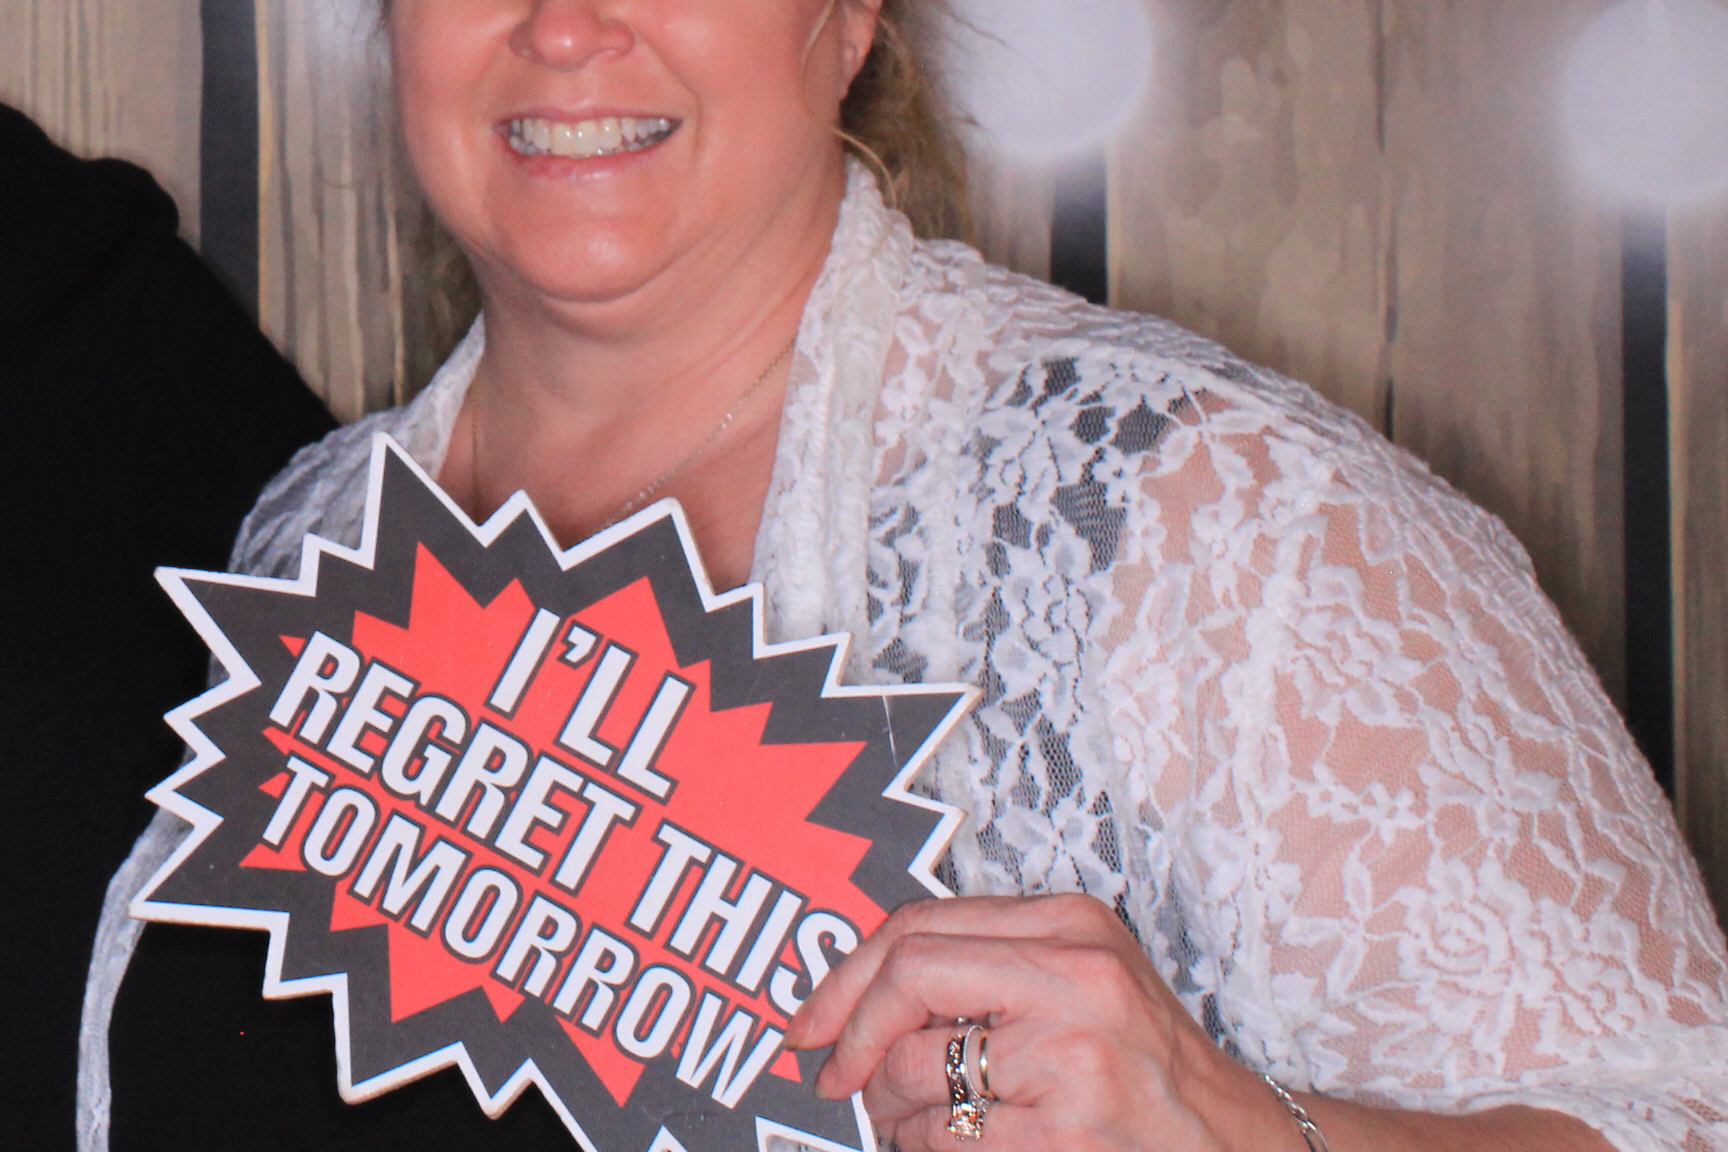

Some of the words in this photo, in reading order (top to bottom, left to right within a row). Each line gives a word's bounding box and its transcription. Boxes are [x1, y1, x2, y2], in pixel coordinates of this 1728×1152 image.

[267, 629, 637, 892] REGRET
[629, 822, 861, 1016] THIS
[489, 607, 692, 798] I'LL
[260, 756, 786, 1110] TOMORROW
